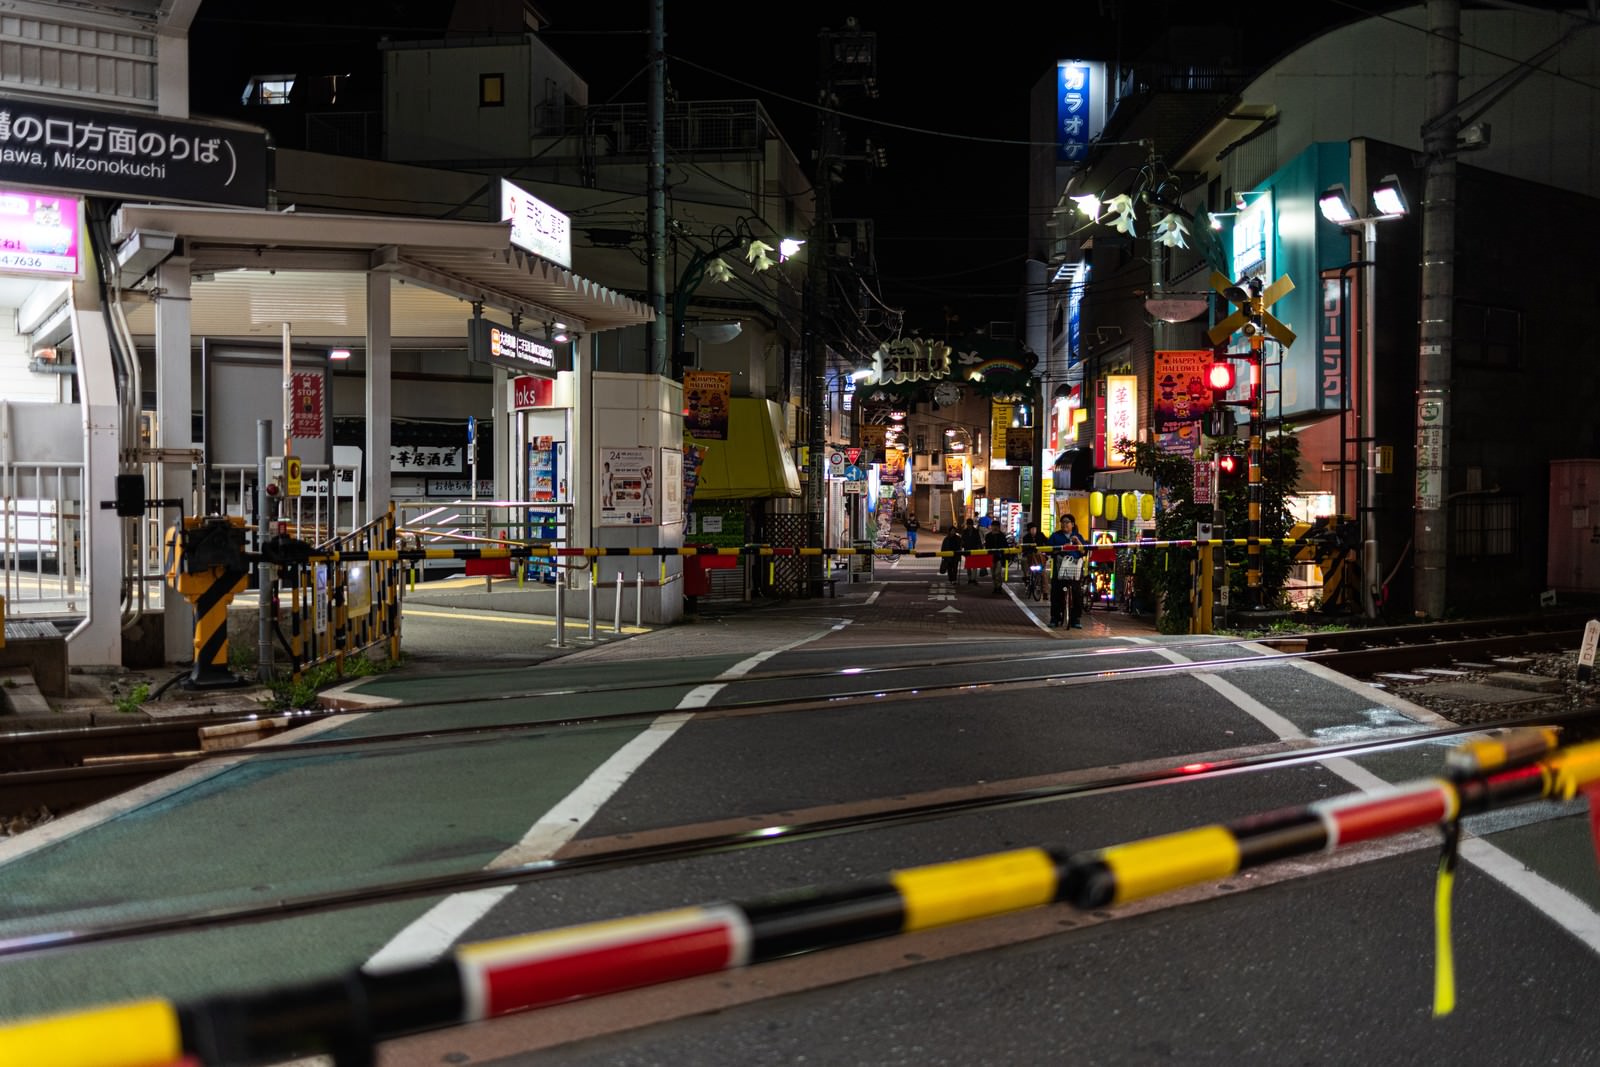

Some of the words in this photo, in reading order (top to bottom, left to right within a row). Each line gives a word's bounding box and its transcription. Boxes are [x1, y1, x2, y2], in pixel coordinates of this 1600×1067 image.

[1064, 69, 1083, 158] カラオケ
[54, 151, 166, 179] Mizonokuchi
[297, 388, 318, 397] STOP
[515, 384, 536, 406] toks
[390, 450, 458, 468] 華居酒屋
[609, 451, 621, 460] 24
